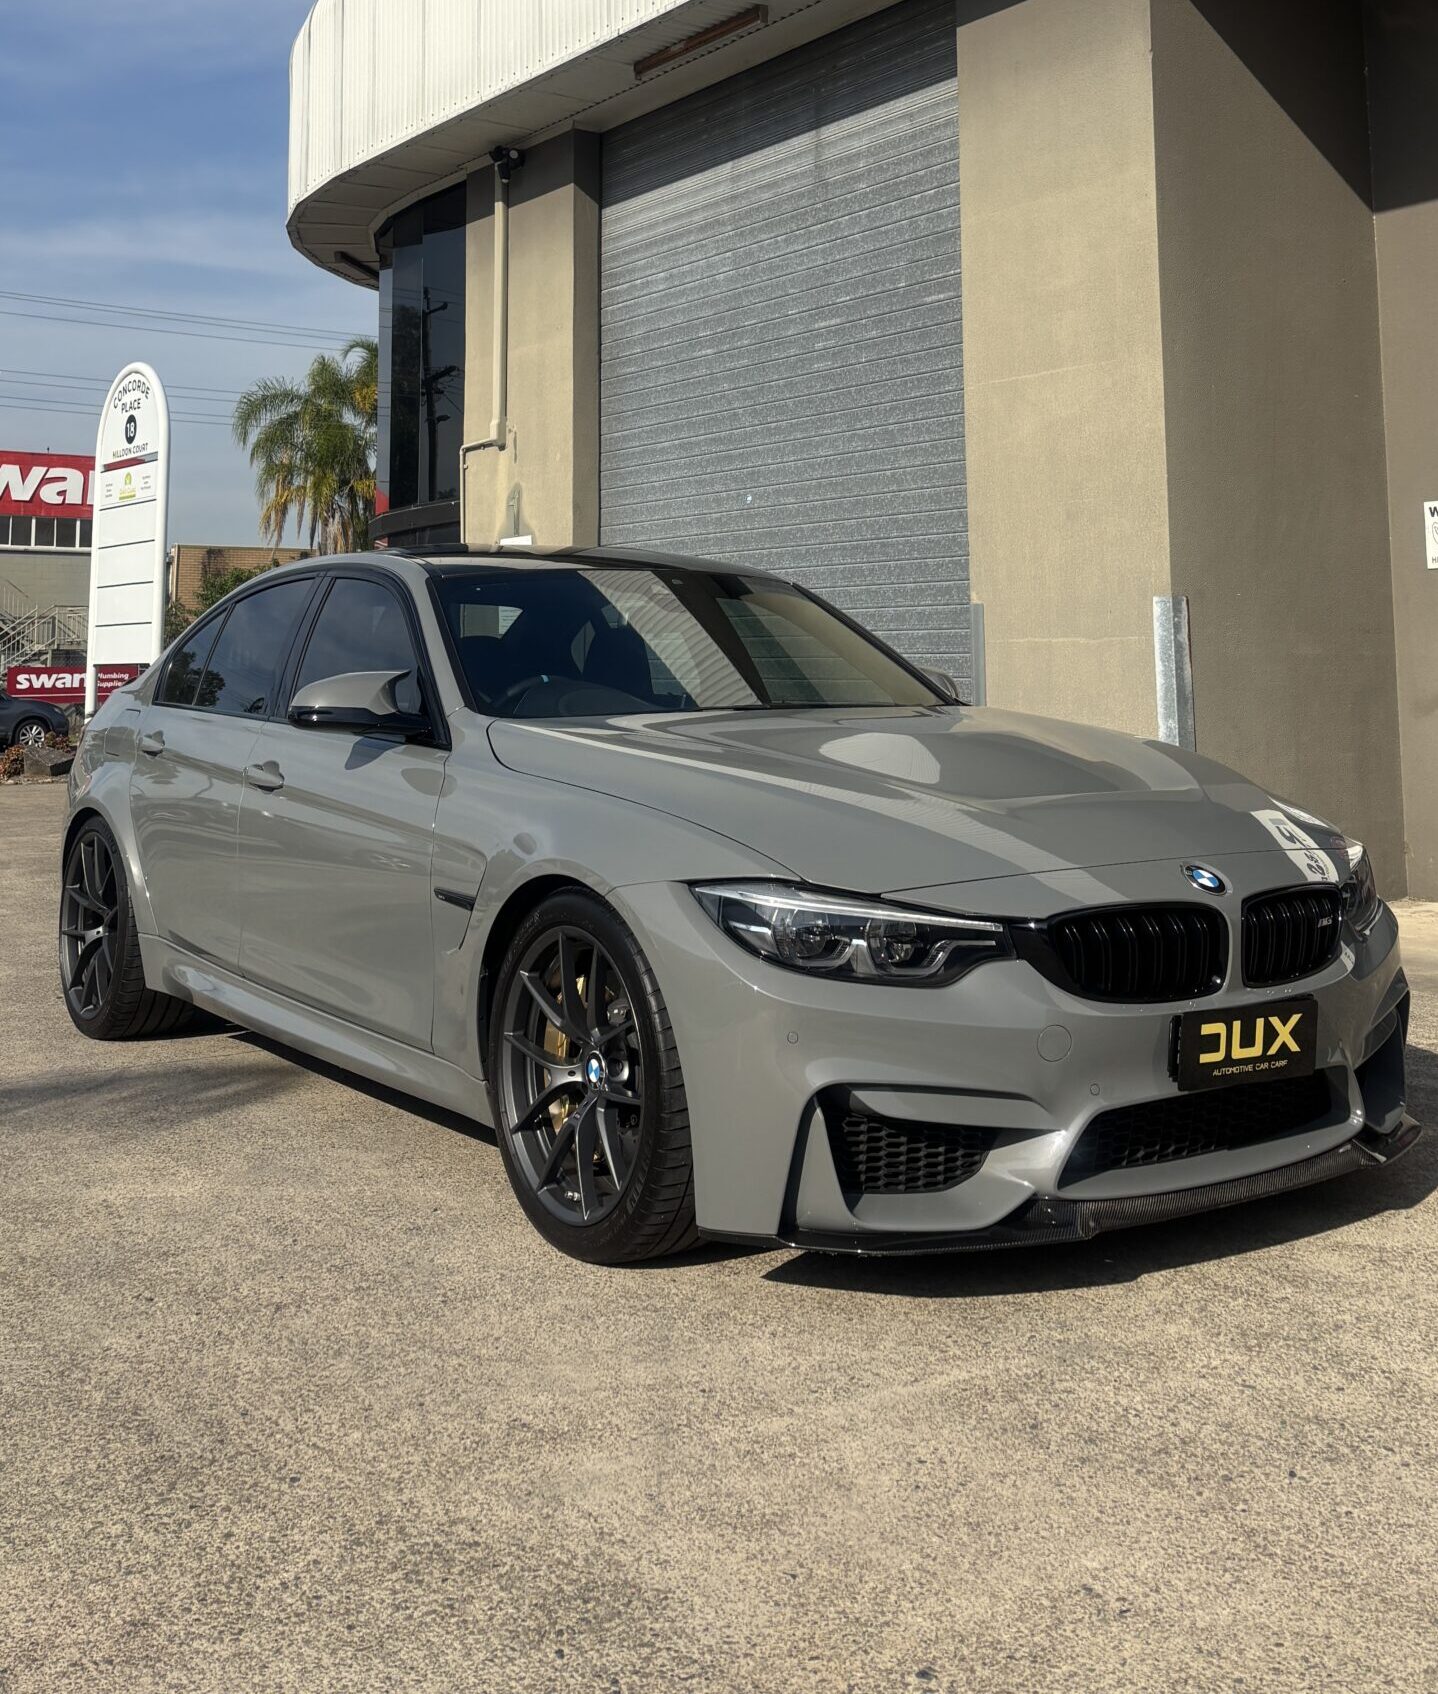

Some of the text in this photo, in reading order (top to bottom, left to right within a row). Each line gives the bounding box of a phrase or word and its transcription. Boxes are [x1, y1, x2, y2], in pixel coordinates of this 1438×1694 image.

[113, 379, 151, 409] CONCORDE
[121, 398, 141, 414] PLACE
[126, 421, 135, 438] 18
[133, 442, 148, 454] COURT
[0, 464, 95, 504] wa
[1212, 1065, 1253, 1076] AUTOMOTIVE
[1255, 1063, 1269, 1071] CAR
